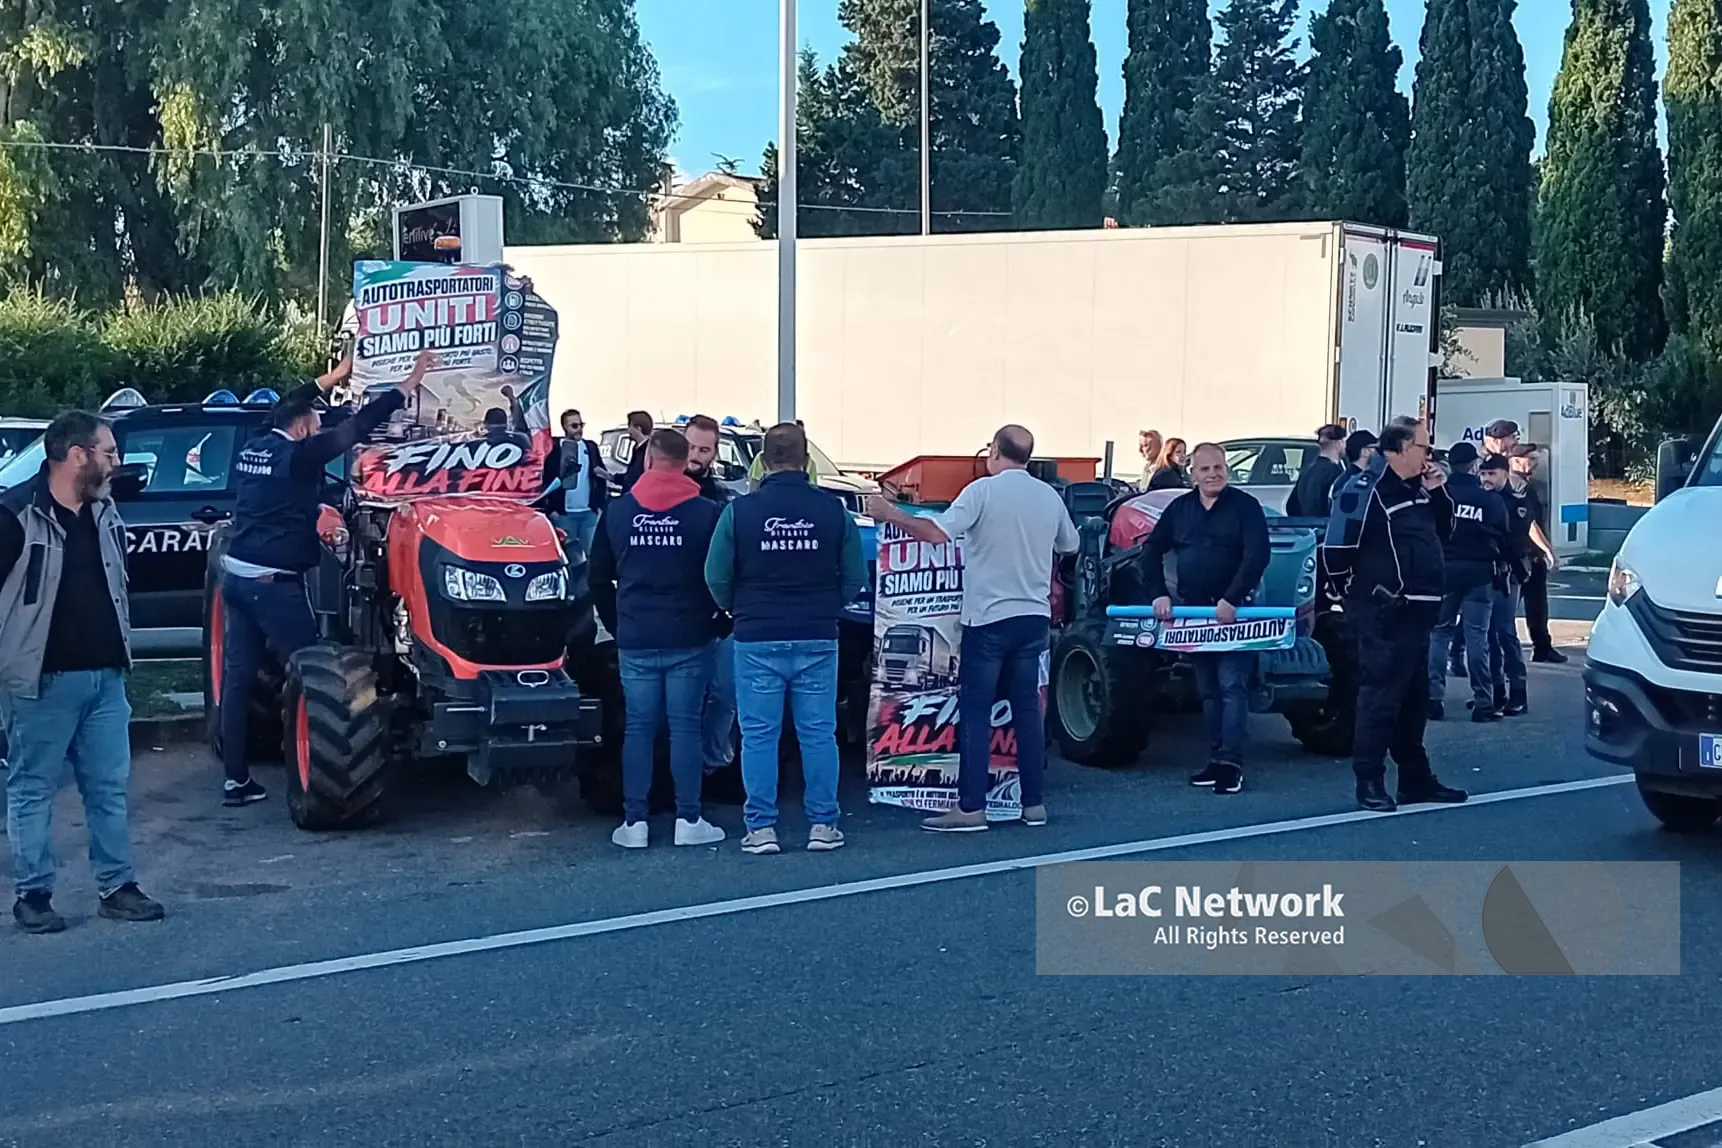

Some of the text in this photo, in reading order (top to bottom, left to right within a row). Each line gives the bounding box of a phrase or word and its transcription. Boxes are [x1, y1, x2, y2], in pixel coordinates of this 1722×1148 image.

[362, 276, 494, 305] AUTOTRASPORTATORI
[367, 295, 486, 334] UNITI
[363, 331, 420, 358] SIAMO
[424, 325, 450, 348] PIÙ
[454, 322, 497, 346] FORTI
[383, 442, 523, 477] FINO
[364, 468, 543, 495] ALLA FINE
[1454, 504, 1483, 523] IZIA
[630, 535, 683, 546] MASCARO
[761, 539, 819, 551] MASCARO
[885, 566, 959, 595] SIAMO PIÙ
[1164, 619, 1287, 645] AUTOTRASPORTATORI
[873, 723, 956, 753] ALLA
